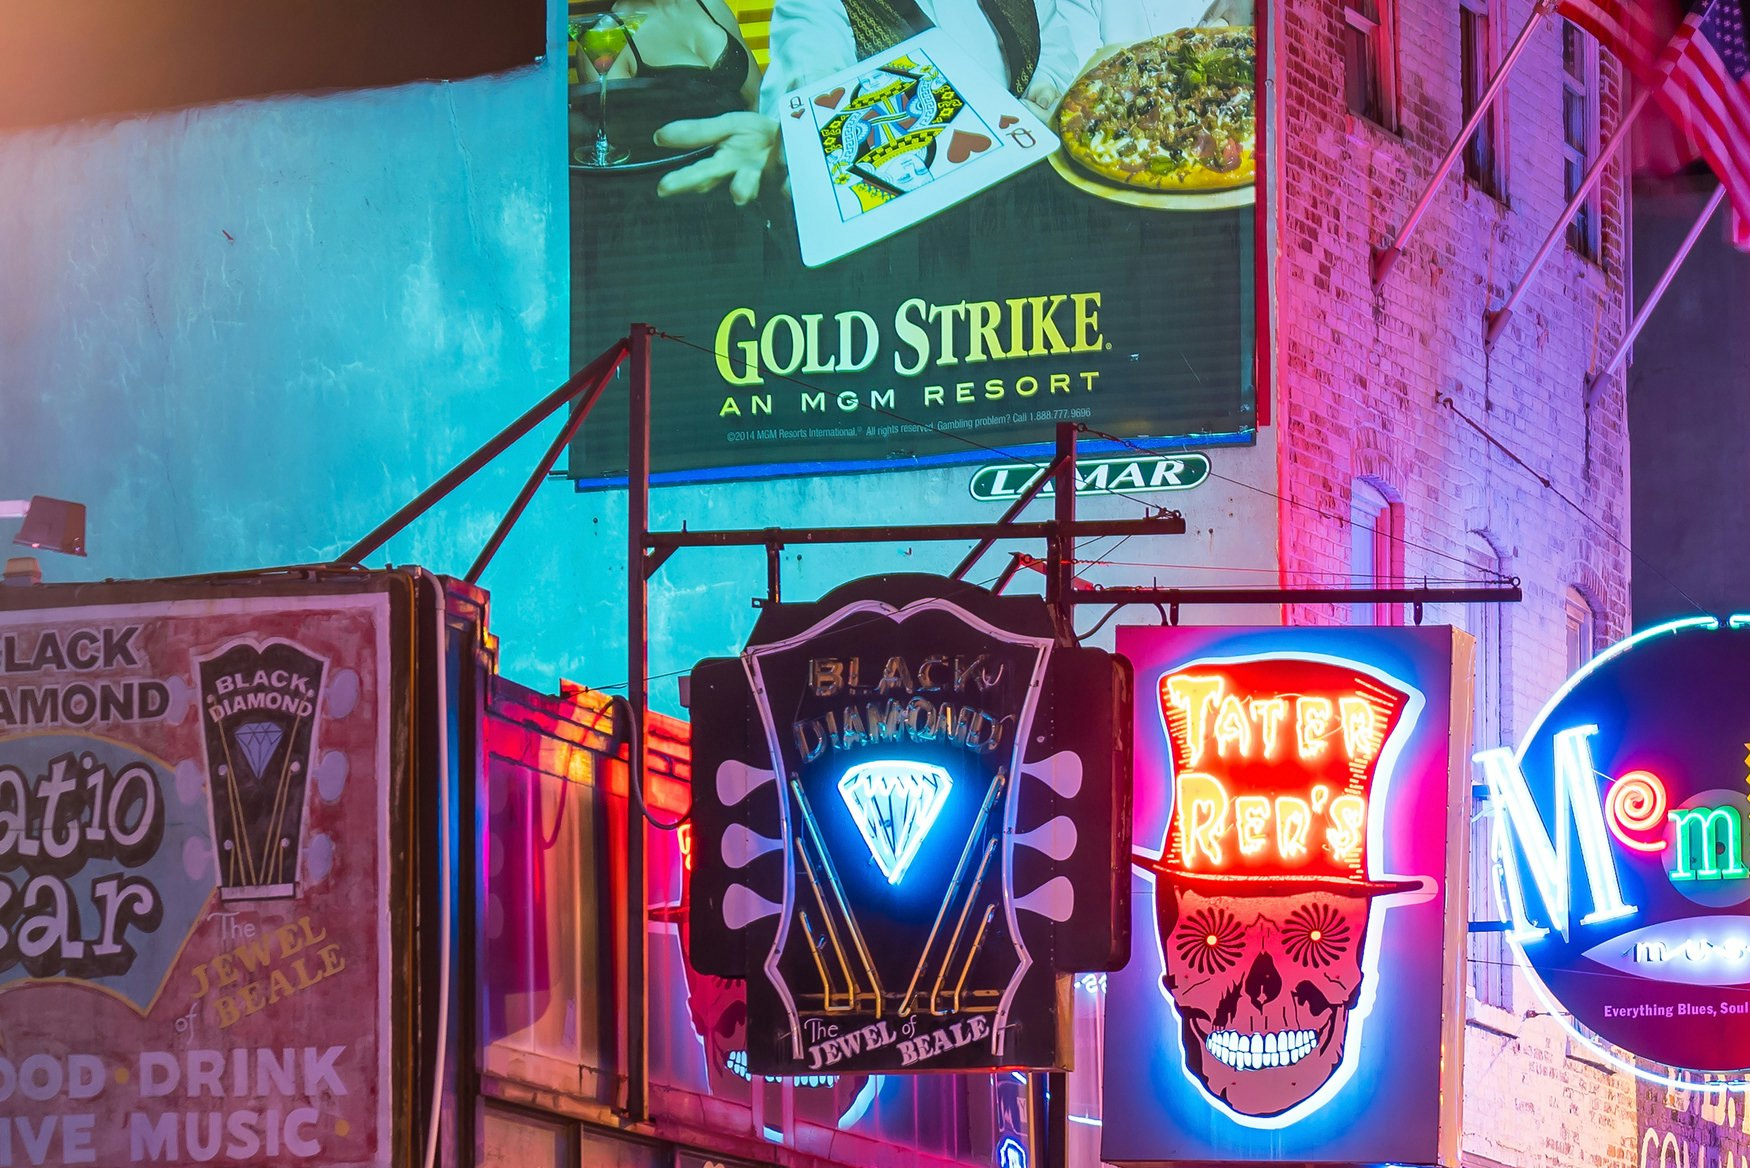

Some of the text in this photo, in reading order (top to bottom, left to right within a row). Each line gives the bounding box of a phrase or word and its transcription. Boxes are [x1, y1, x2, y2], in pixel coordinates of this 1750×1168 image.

[714, 306, 880, 387] GOLD
[720, 371, 1101, 419] AN MGM RESORT
[757, 429, 777, 440] MGM
[779, 428, 807, 439] Resorts
[866, 426, 876, 436] All
[877, 425, 899, 438] rights
[937, 421, 973, 433] Gambling
[975, 414, 1011, 428] problem?
[1013, 413, 1027, 422] Call
[0, 628, 141, 673] LACK
[215, 669, 309, 695] BLACK
[809, 655, 985, 696] BLACK
[209, 691, 313, 724] DIAMOND
[793, 697, 1003, 764] DIAMOND
[1168, 676, 1376, 765] TATER
[1176, 775, 1368, 867] RED'S
[206, 911, 256, 940] The
[192, 916, 327, 999] JEWEL
[215, 944, 346, 1029] BEALE
[1604, 1005, 1674, 1018] Everything
[1678, 1003, 1717, 1017] Blues,
[1720, 1002, 1749, 1015] Soul
[175, 1002, 199, 1042] of
[804, 1018, 838, 1042] The
[808, 1015, 990, 1070] JEWEL of BEALE
[139, 1046, 349, 1097] DRINK
[130, 1107, 321, 1163] MUSIC
